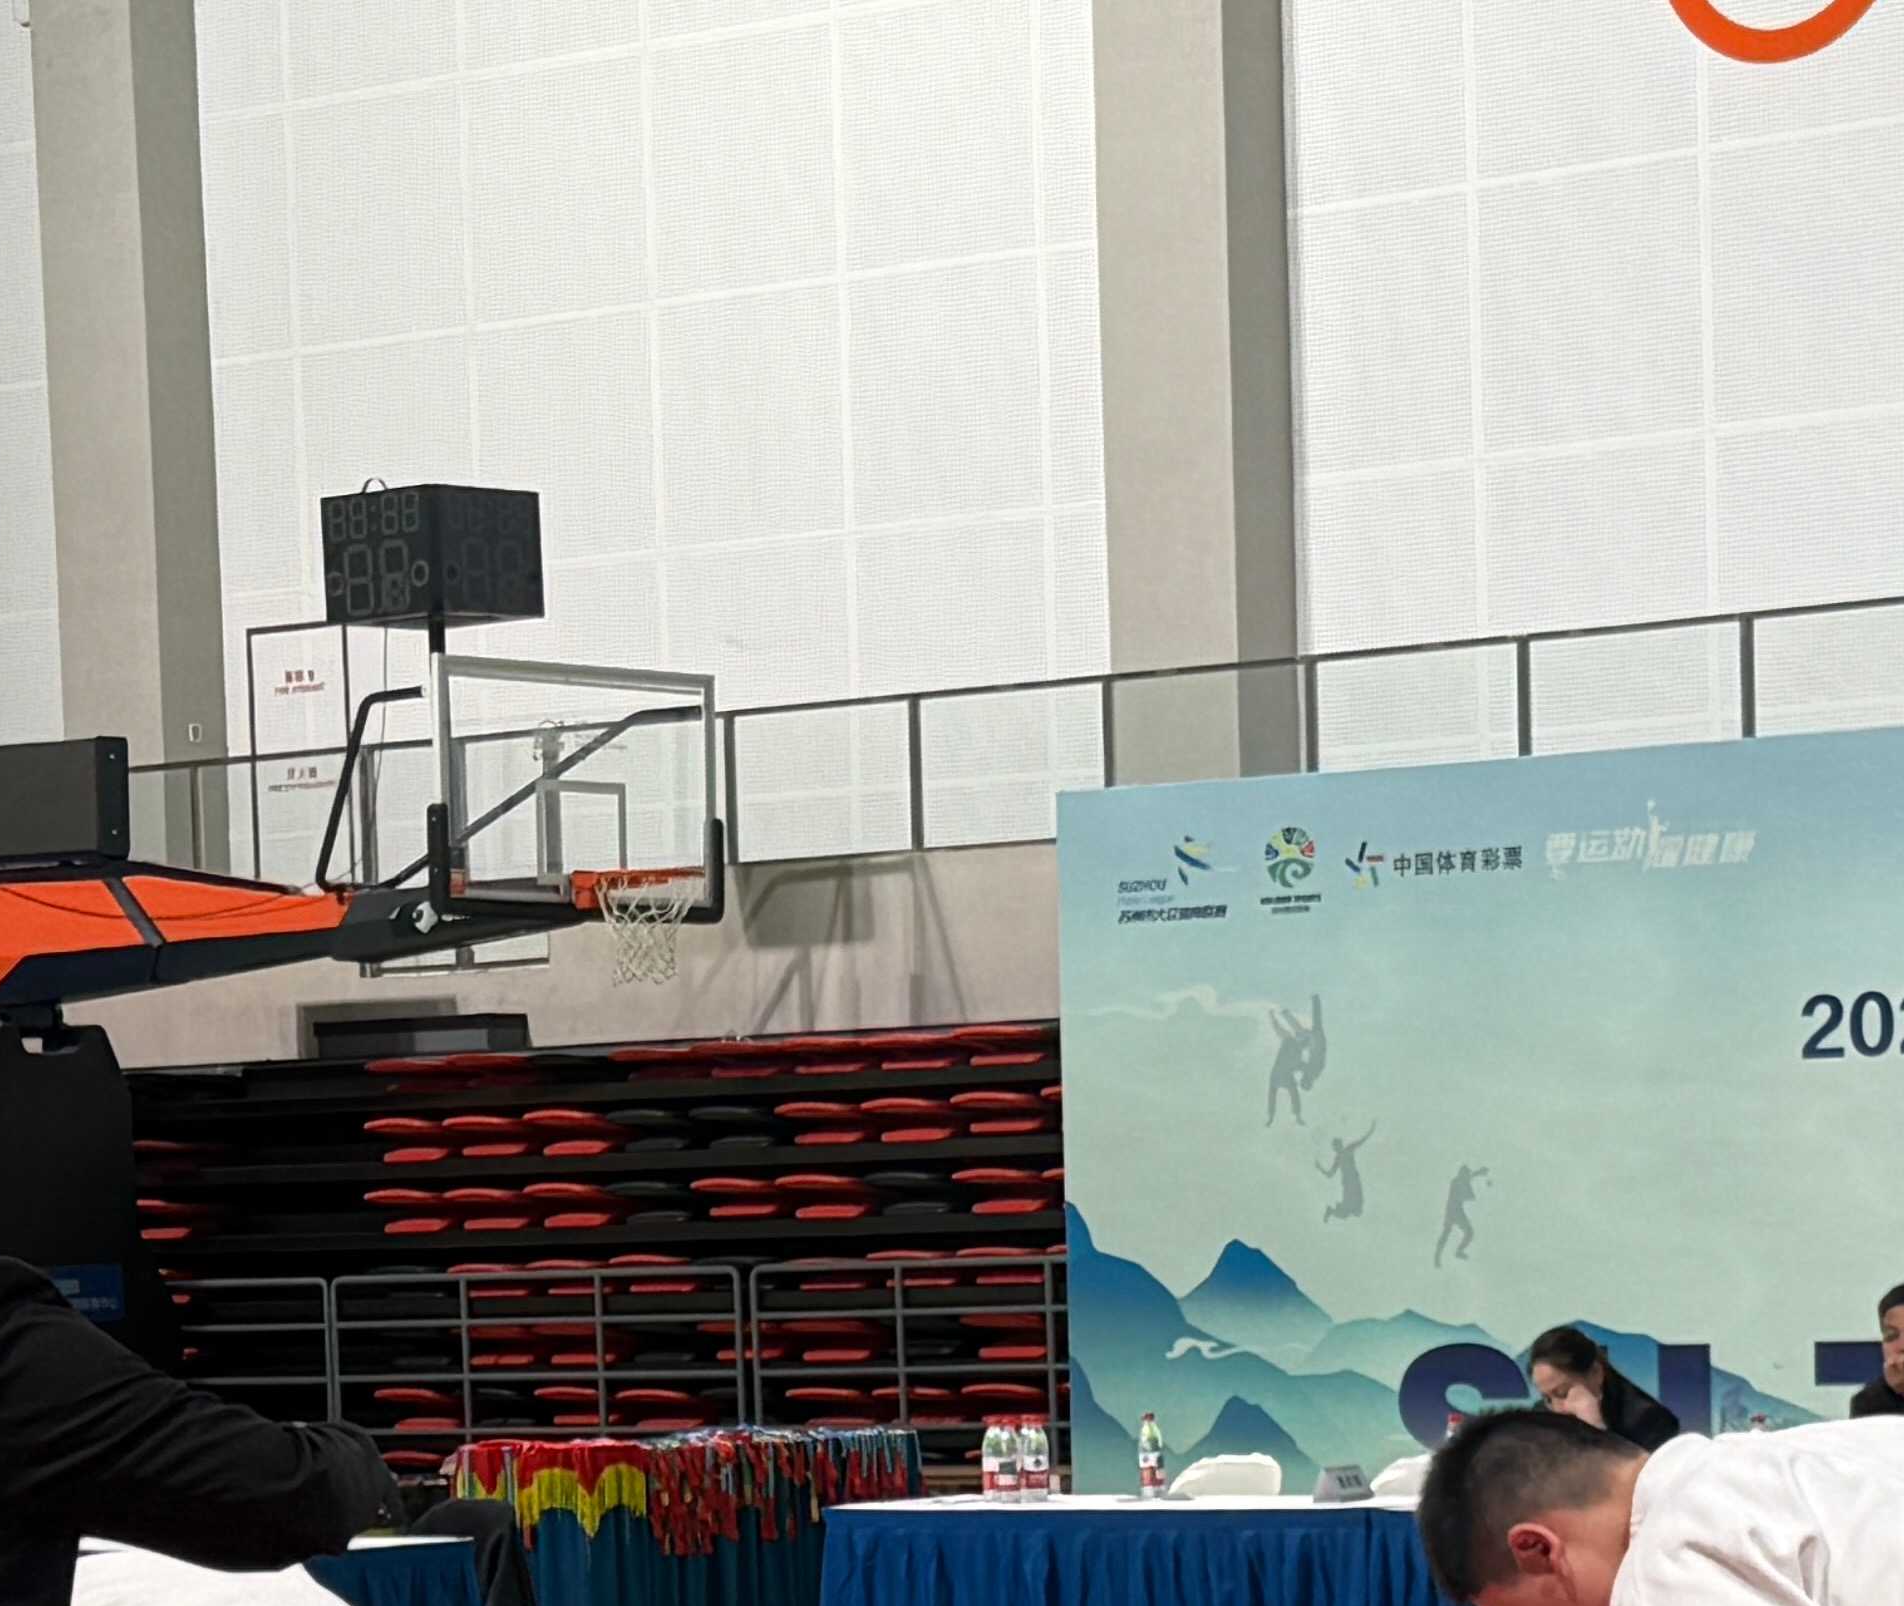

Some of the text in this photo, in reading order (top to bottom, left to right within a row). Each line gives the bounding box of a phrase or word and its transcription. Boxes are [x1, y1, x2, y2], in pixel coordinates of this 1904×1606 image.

[1394, 845, 1523, 878] 中国体育彩票
